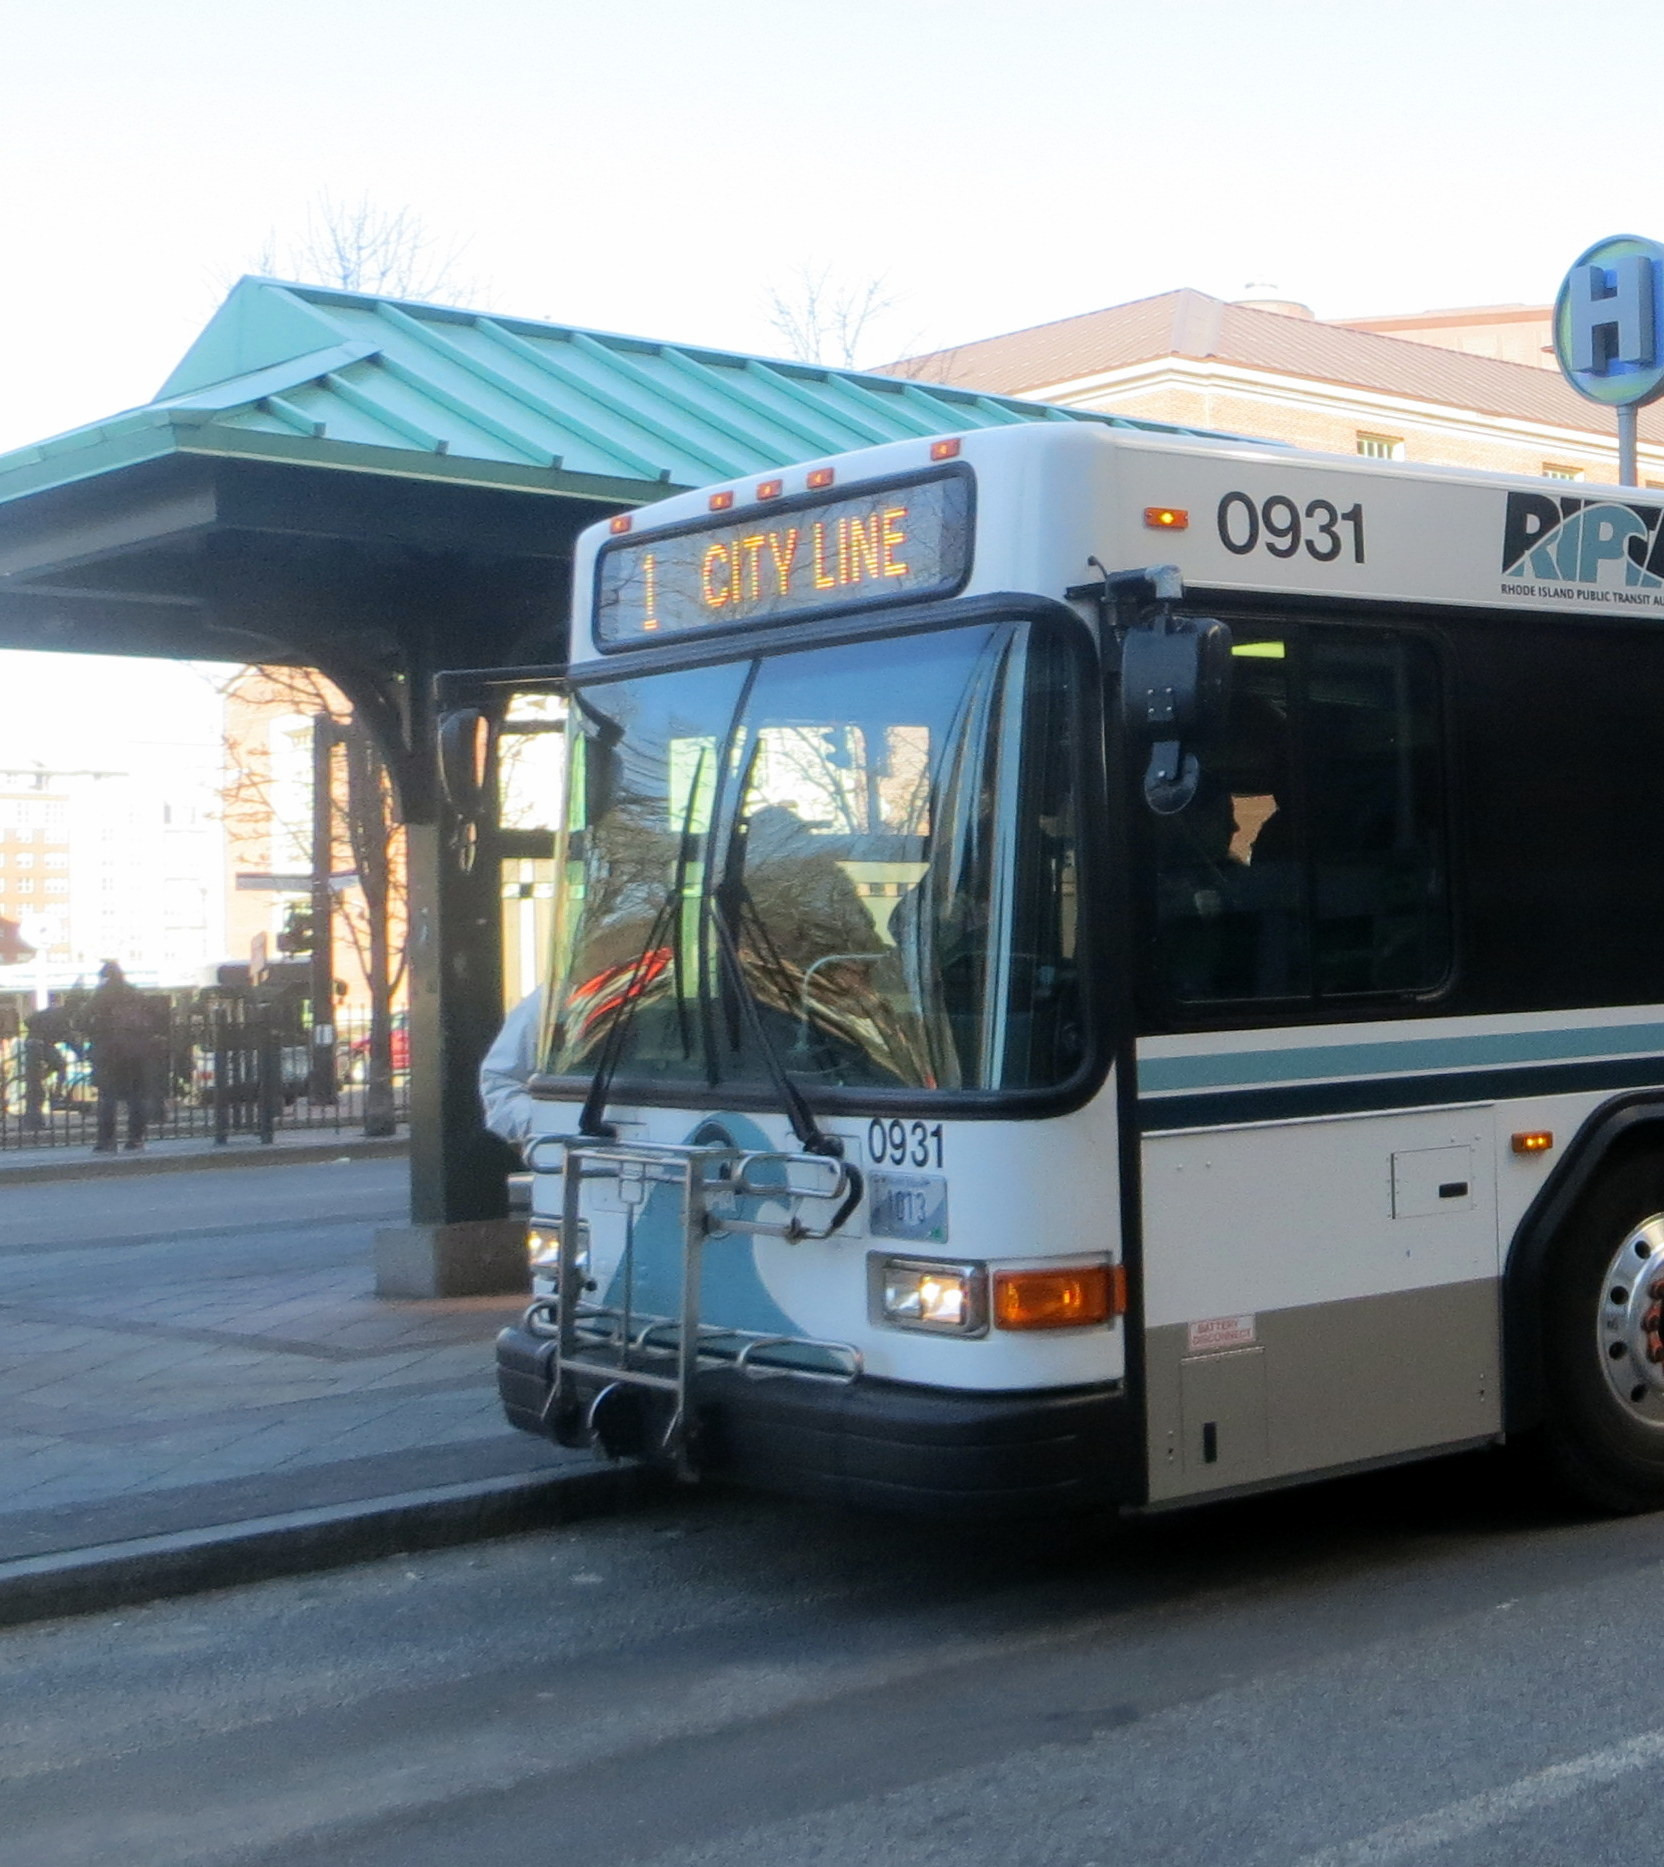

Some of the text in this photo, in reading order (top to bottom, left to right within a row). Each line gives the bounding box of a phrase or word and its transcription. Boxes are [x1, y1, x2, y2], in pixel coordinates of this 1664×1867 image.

[1217, 491, 1365, 564] 0931
[642, 507, 909, 631] 1 CITY LINE
[1501, 583, 1536, 597] RHODE
[1538, 586, 1575, 600] ISLAND
[1577, 590, 1611, 602] PUBLIC
[1612, 592, 1651, 605] TRANSIT
[867, 1118, 944, 1168] 0931
